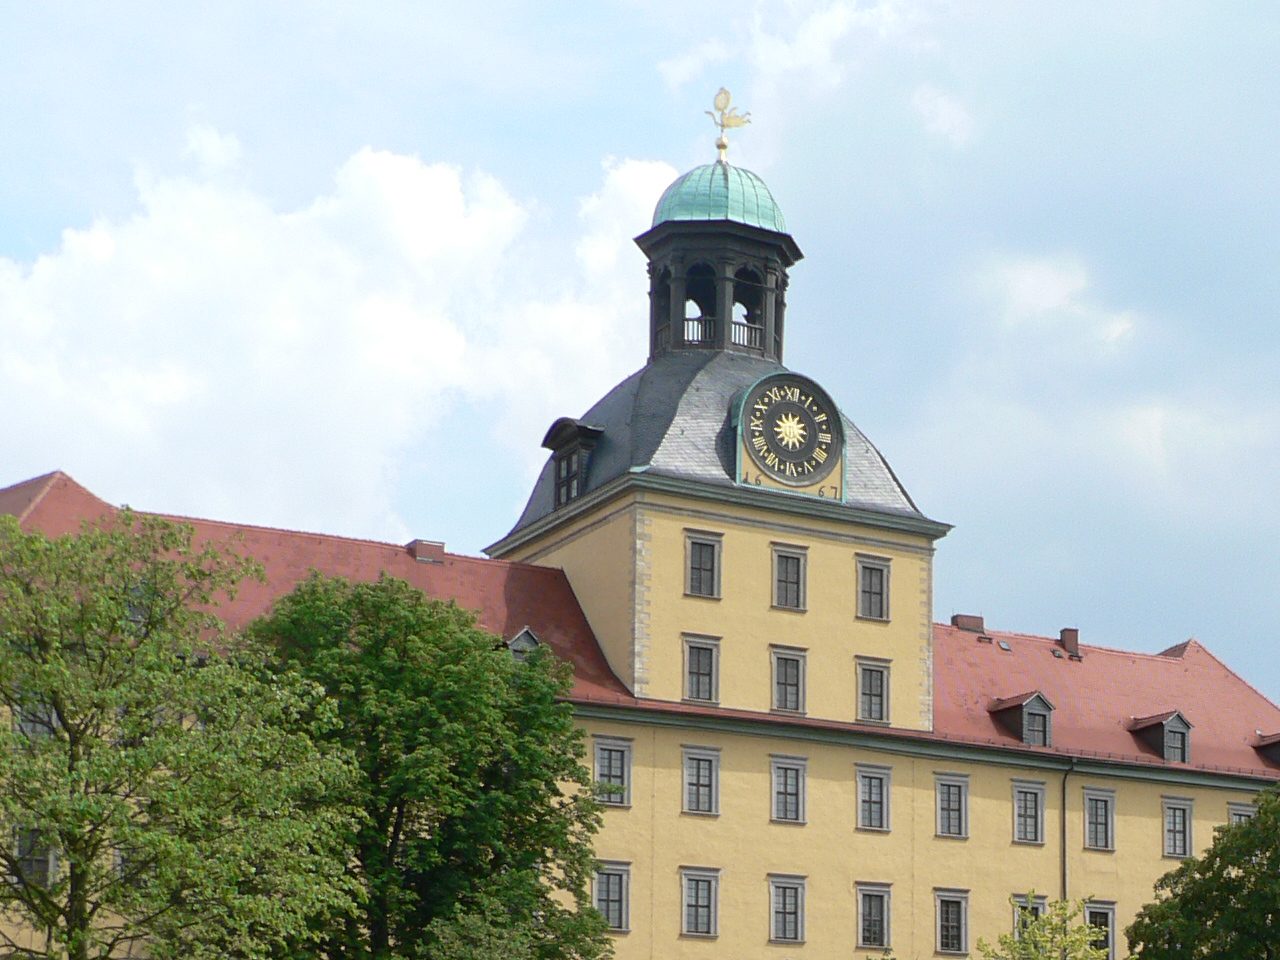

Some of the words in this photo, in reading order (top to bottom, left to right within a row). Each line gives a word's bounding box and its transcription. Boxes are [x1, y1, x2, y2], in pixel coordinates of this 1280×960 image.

[766, 387, 781, 403] XI
[784, 385, 800, 402] XII
[754, 398, 768, 414] X
[804, 396, 813, 408] I
[750, 415, 763, 430] IX
[814, 413, 828, 422] II
[818, 433, 832, 443] III
[765, 452, 779, 471] VII
[804, 461, 814, 474] V
[786, 462, 797, 477] VI
[818, 485, 838, 500] 67
